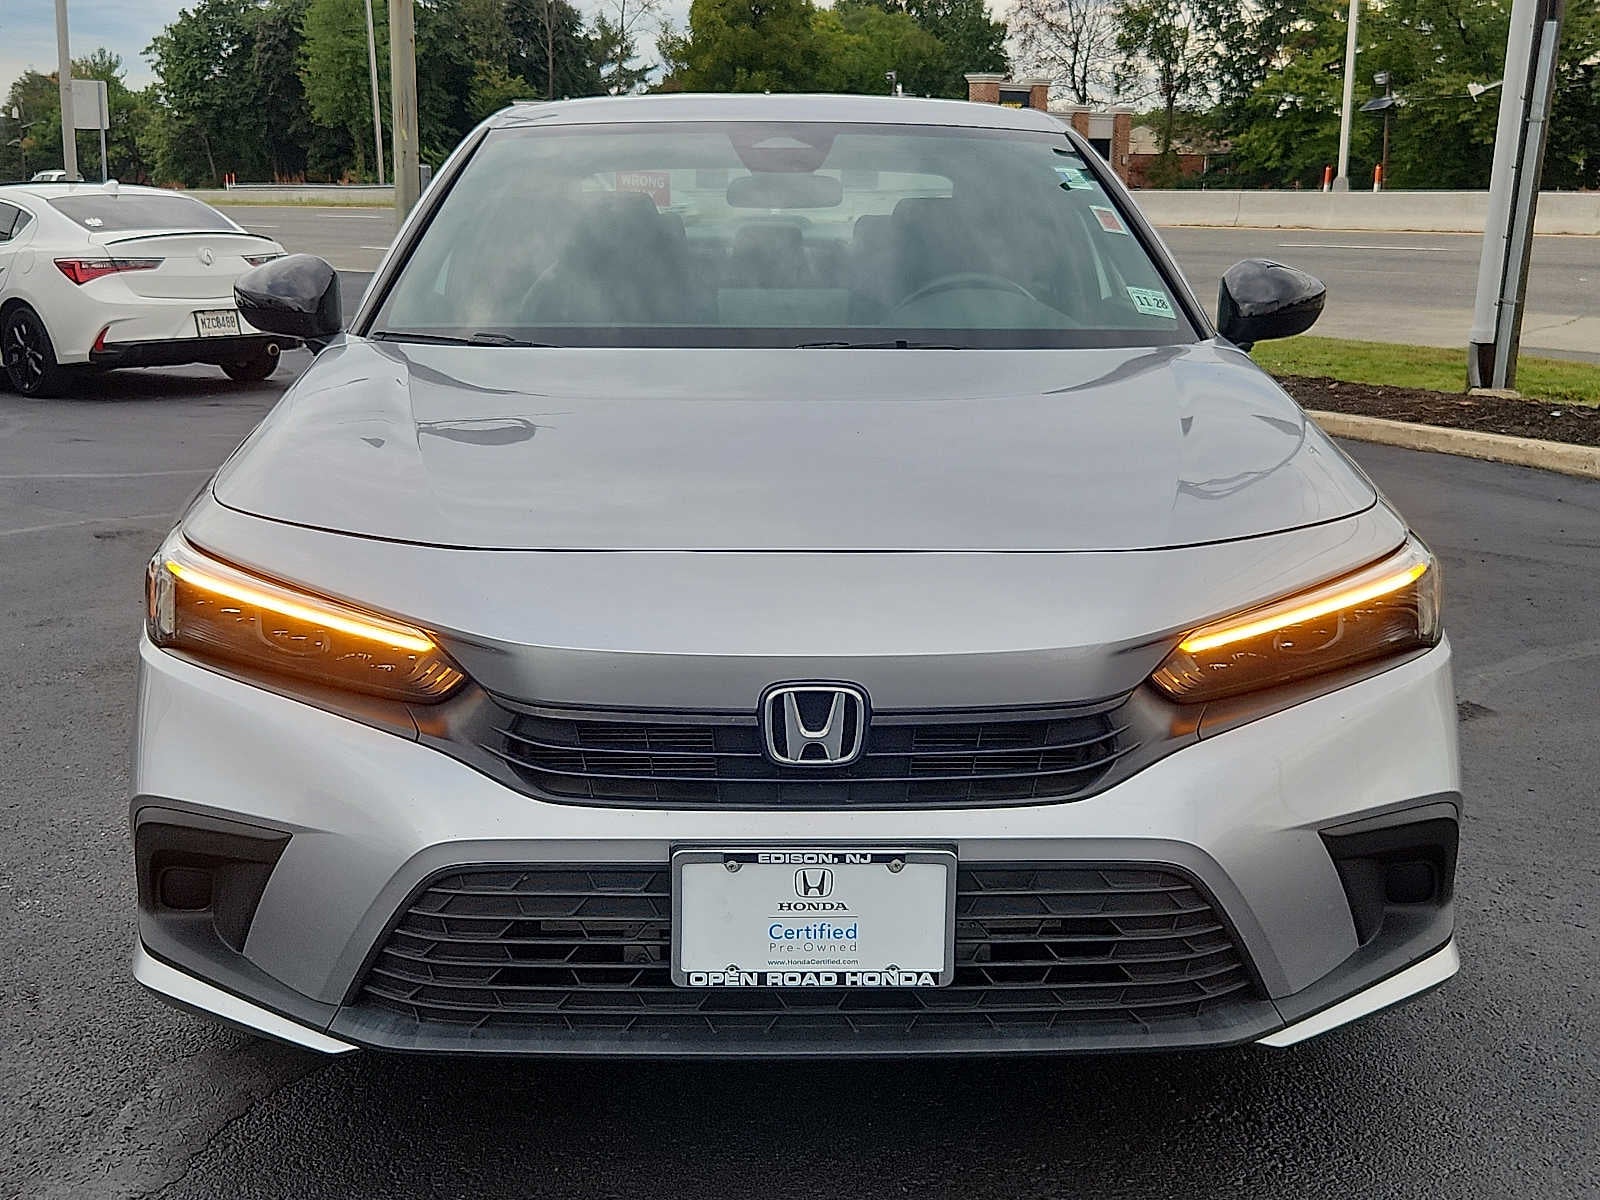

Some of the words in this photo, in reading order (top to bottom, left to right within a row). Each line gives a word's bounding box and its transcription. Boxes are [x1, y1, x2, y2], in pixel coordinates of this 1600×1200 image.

[621, 174, 665, 189] WRONG
[758, 853, 839, 864] EDISON,
[845, 853, 872, 864] NJ
[777, 902, 849, 911] HONDA
[768, 922, 858, 940] Certified
[768, 942, 858, 952] Pre-Owned
[767, 958, 859, 966] www.HondaCertified.com
[689, 972, 758, 986] OPEN
[766, 972, 838, 986] ROAD
[845, 972, 936, 986] HONDA
